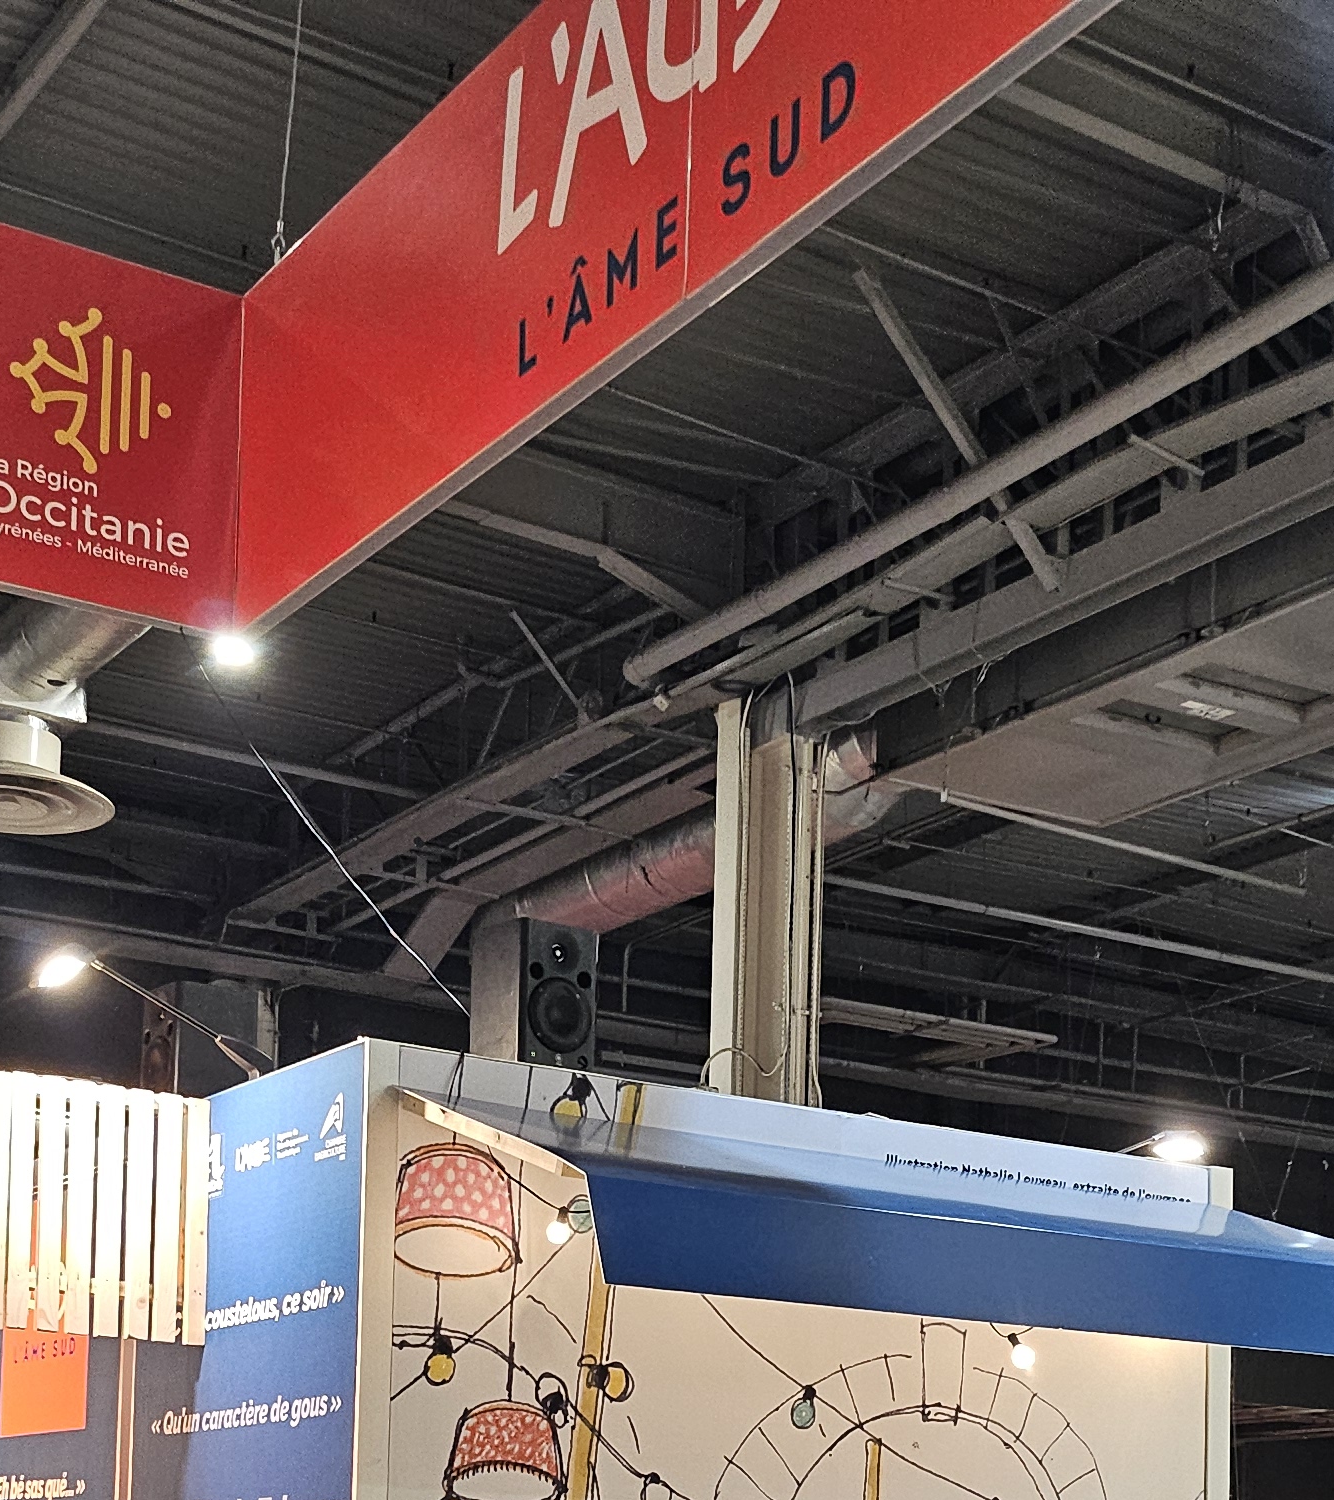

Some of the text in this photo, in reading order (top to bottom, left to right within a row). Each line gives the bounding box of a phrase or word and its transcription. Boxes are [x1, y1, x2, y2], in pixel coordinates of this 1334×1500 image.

[517, 60, 855, 377] L'ÂME SUD
[16, 460, 98, 498] Région
[76, 539, 190, 580] Méditerranée
[282, 1292, 301, 1316] ce
[302, 1280, 332, 1312] soir
[53, 1336, 76, 1358] SUD
[163, 1407, 200, 1435] Qu'un
[201, 1399, 268, 1432] caractère
[270, 1395, 290, 1423] de
[290, 1395, 328, 1428] gous
[24, 1479, 45, 1500] sas
